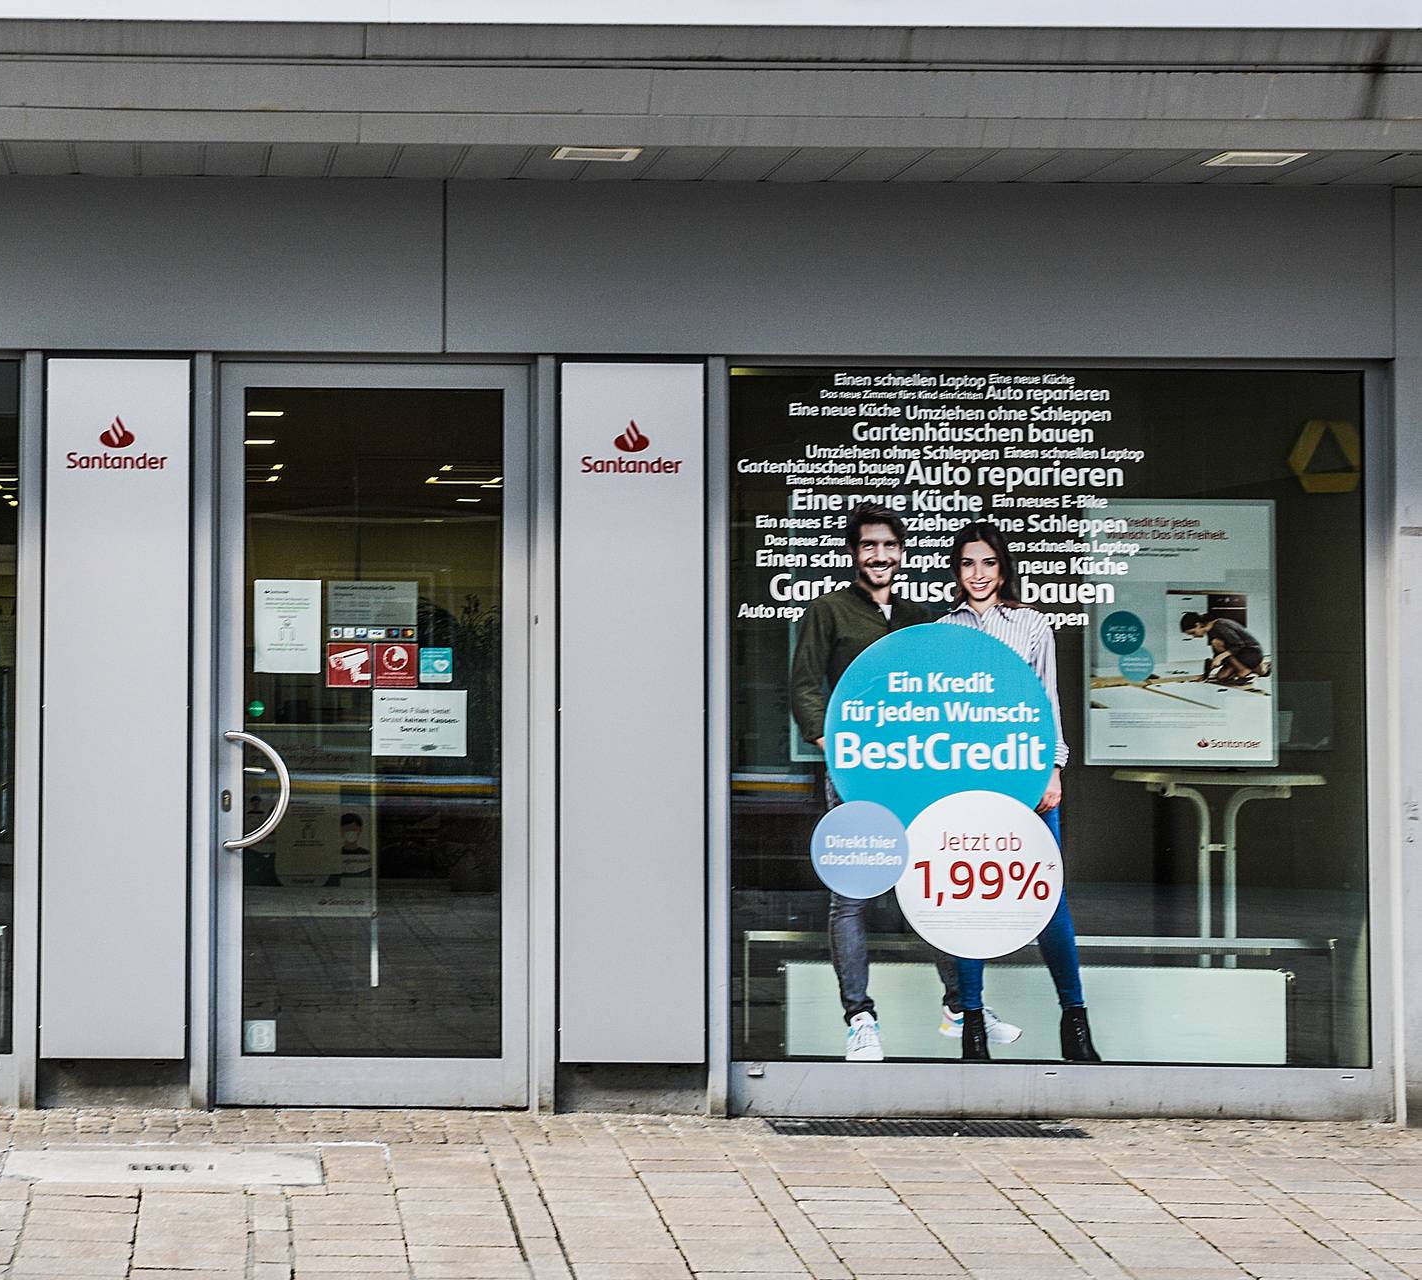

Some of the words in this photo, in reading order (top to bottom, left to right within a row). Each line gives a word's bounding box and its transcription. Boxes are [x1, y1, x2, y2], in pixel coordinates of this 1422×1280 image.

[834, 373, 871, 386] Einen
[873, 374, 936, 387] schnellen
[939, 374, 986, 390] Laptop
[988, 374, 1012, 385] Eine
[1014, 376, 1041, 385] neue
[1042, 374, 1075, 385] Küche
[820, 390, 838, 399] Das
[839, 391, 861, 399] neue
[862, 390, 898, 399] Zimmer
[918, 390, 938, 399] Kind
[985, 385, 1023, 401] Auto
[1027, 386, 1110, 404] reparieren
[788, 402, 819, 416] Eine
[821, 406, 856, 416] neue
[859, 403, 901, 417] Küche
[906, 405, 985, 421] Umziehen
[987, 405, 1028, 421] ohne
[1030, 406, 1112, 425] Schleppen
[852, 422, 1023, 442] Gartenhäuschen
[1028, 423, 1094, 443] bauen
[66, 452, 168, 469] Santander
[805, 444, 880, 459] Umziehen
[882, 445, 921, 459] ohne
[922, 445, 1000, 463] Schleppen
[1003, 446, 1039, 459] Einen
[1040, 447, 1099, 460] schnellen
[1100, 448, 1144, 462] Laptop
[581, 456, 682, 474] Santander
[737, 459, 856, 474] Gartenhäuschen
[858, 460, 905, 474] bauen
[786, 475, 814, 486] Einen
[815, 475, 863, 486] schnellen
[864, 476, 900, 488] Laptop
[905, 460, 971, 486] Auto
[978, 460, 1124, 493] reparieren
[792, 488, 842, 511] Eine
[912, 490, 983, 512] Küche
[992, 494, 1015, 508] Ein
[1016, 497, 1059, 508] neues
[1061, 495, 1108, 508] E-Bike
[755, 515, 777, 528] Ein
[779, 517, 821, 529] neues
[823, 516, 847, 529] E-B
[975, 513, 1024, 533] hne
[1027, 514, 1128, 537] Schleppen
[1170, 518, 1200, 530] jeden
[765, 535, 788, 546] Das
[789, 537, 818, 546] neue
[1151, 530, 1171, 540] Das
[1174, 530, 1185, 540] ist
[1027, 539, 1091, 552] schnellen
[1092, 540, 1139, 556] Laptop
[755, 549, 808, 567] Einen
[1018, 560, 1066, 575] neue
[1070, 557, 1129, 575] Küche
[1021, 576, 1114, 604] bauen
[738, 603, 775, 618] Auto
[888, 672, 923, 693] Ein
[928, 672, 994, 693] Kredit
[841, 701, 874, 722] für
[875, 701, 939, 727] jeden
[944, 702, 1040, 723] Wunsch:
[834, 732, 1046, 771] BestCredit
[1210, 739, 1260, 749] Santander
[825, 834, 868, 849] Direkt
[869, 835, 898, 849] hier
[940, 832, 989, 851] Jetzt
[995, 832, 1022, 851] ab
[819, 852, 903, 866] abschließen
